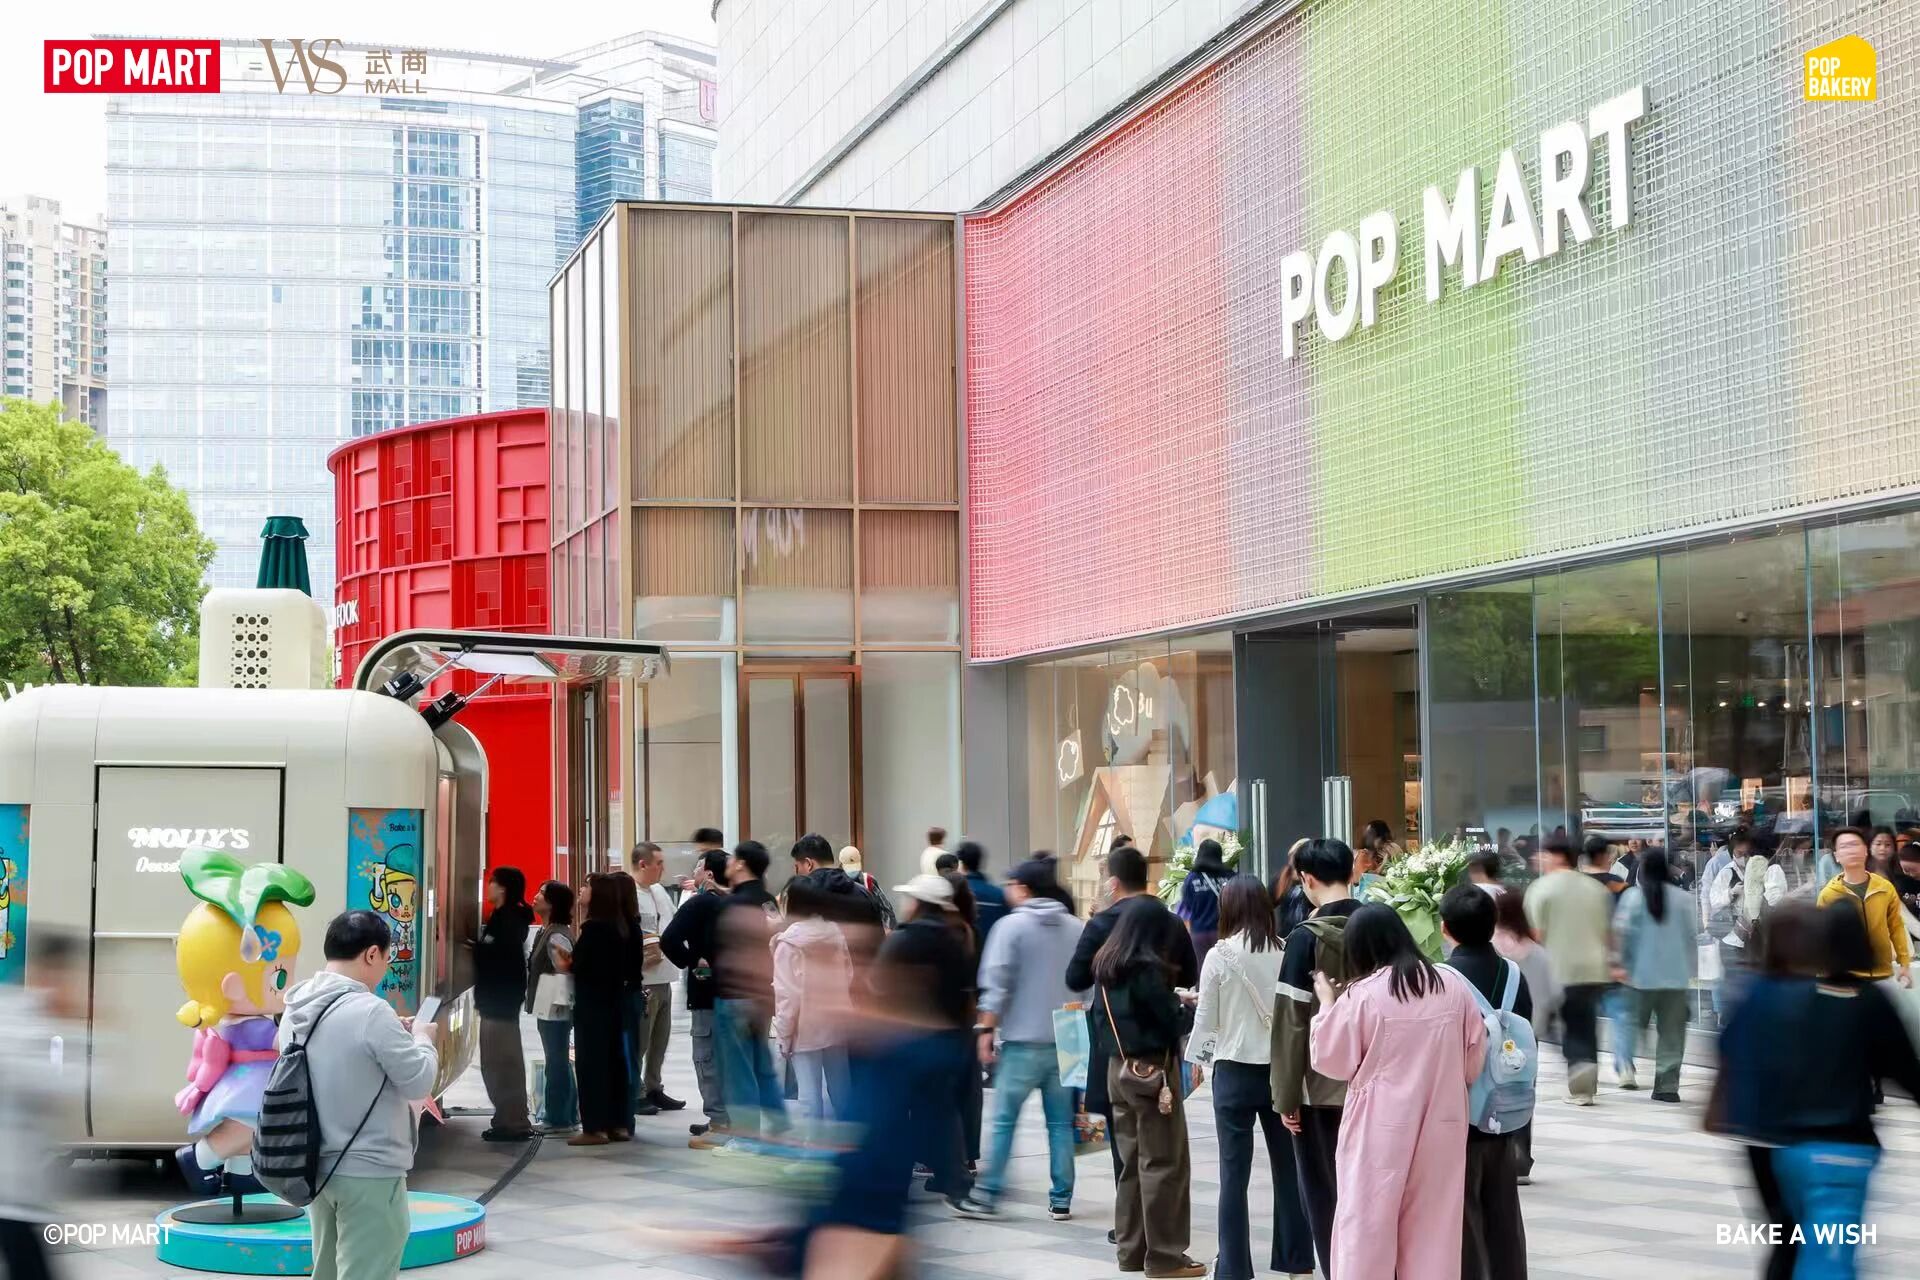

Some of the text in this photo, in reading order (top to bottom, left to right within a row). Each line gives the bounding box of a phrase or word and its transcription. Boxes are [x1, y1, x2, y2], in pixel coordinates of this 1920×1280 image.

[1280, 84, 1650, 360] POP MART
[127, 827, 250, 849] MOLLY'S
[456, 1229, 473, 1254] POP
